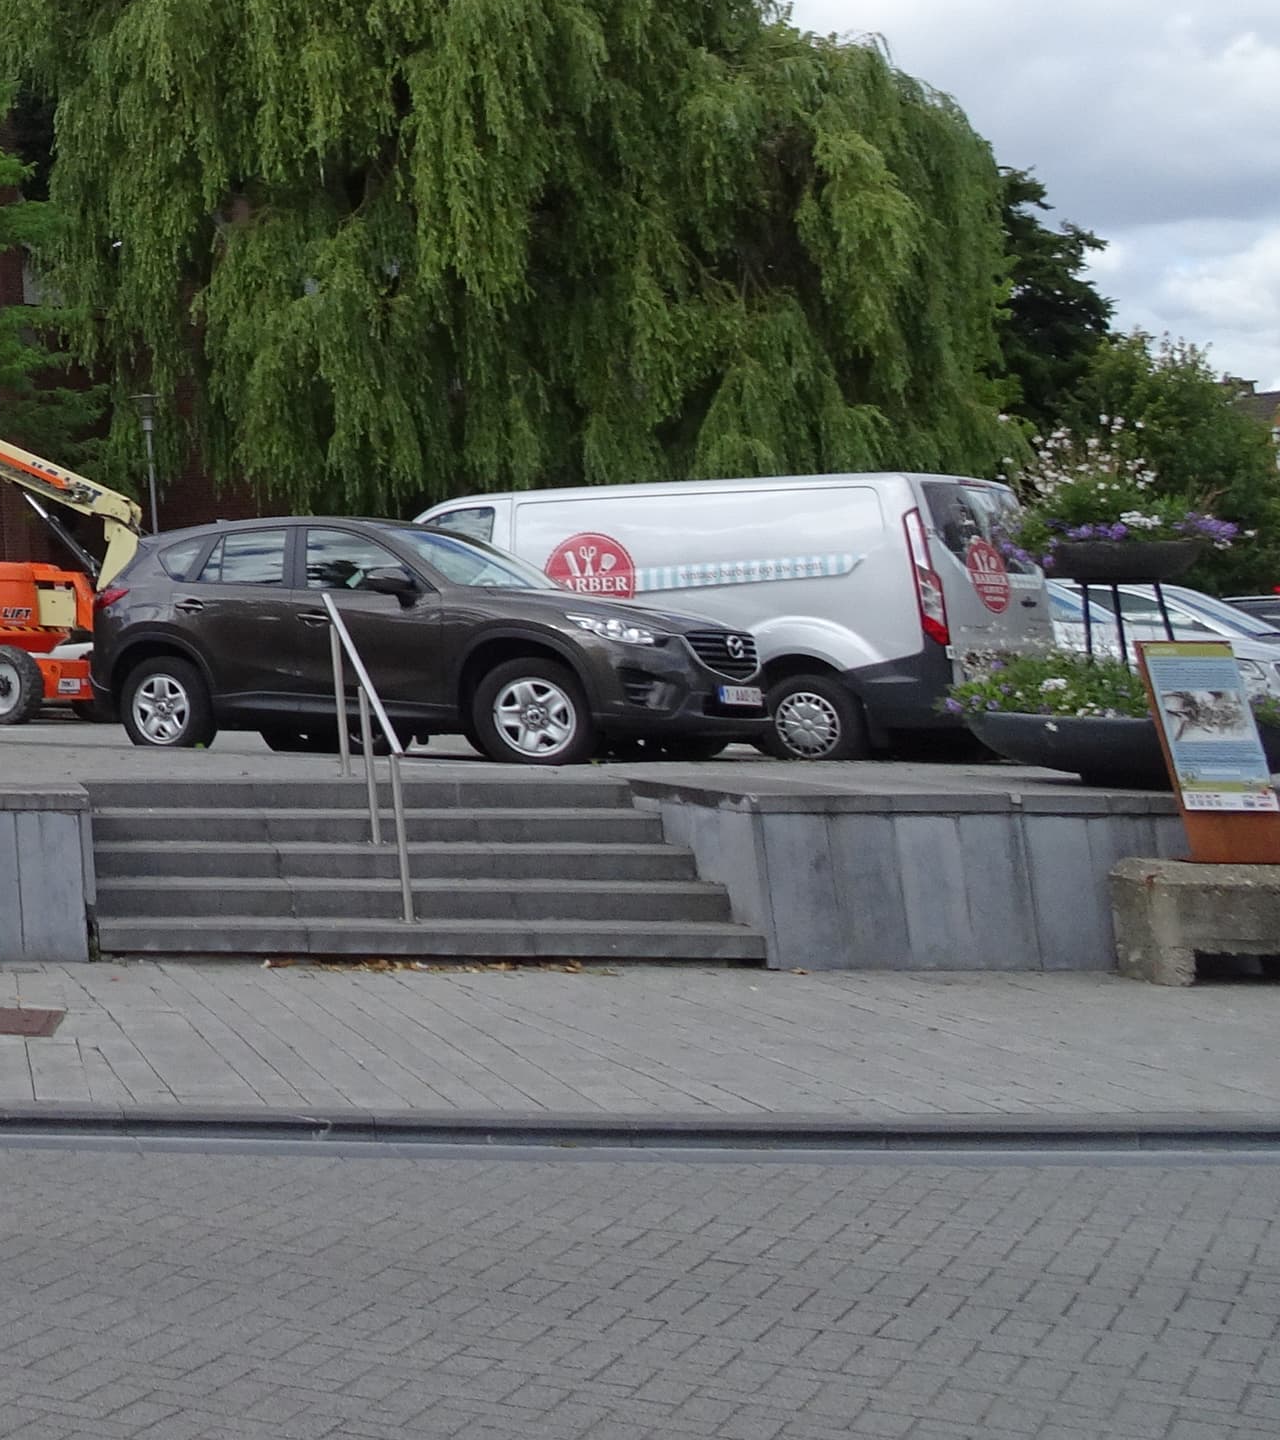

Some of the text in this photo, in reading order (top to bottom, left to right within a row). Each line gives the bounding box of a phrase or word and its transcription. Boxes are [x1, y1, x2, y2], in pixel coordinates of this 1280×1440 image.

[793, 561, 824, 572] event
[564, 576, 629, 593] ARBER
[2, 608, 32, 619] LIFT
